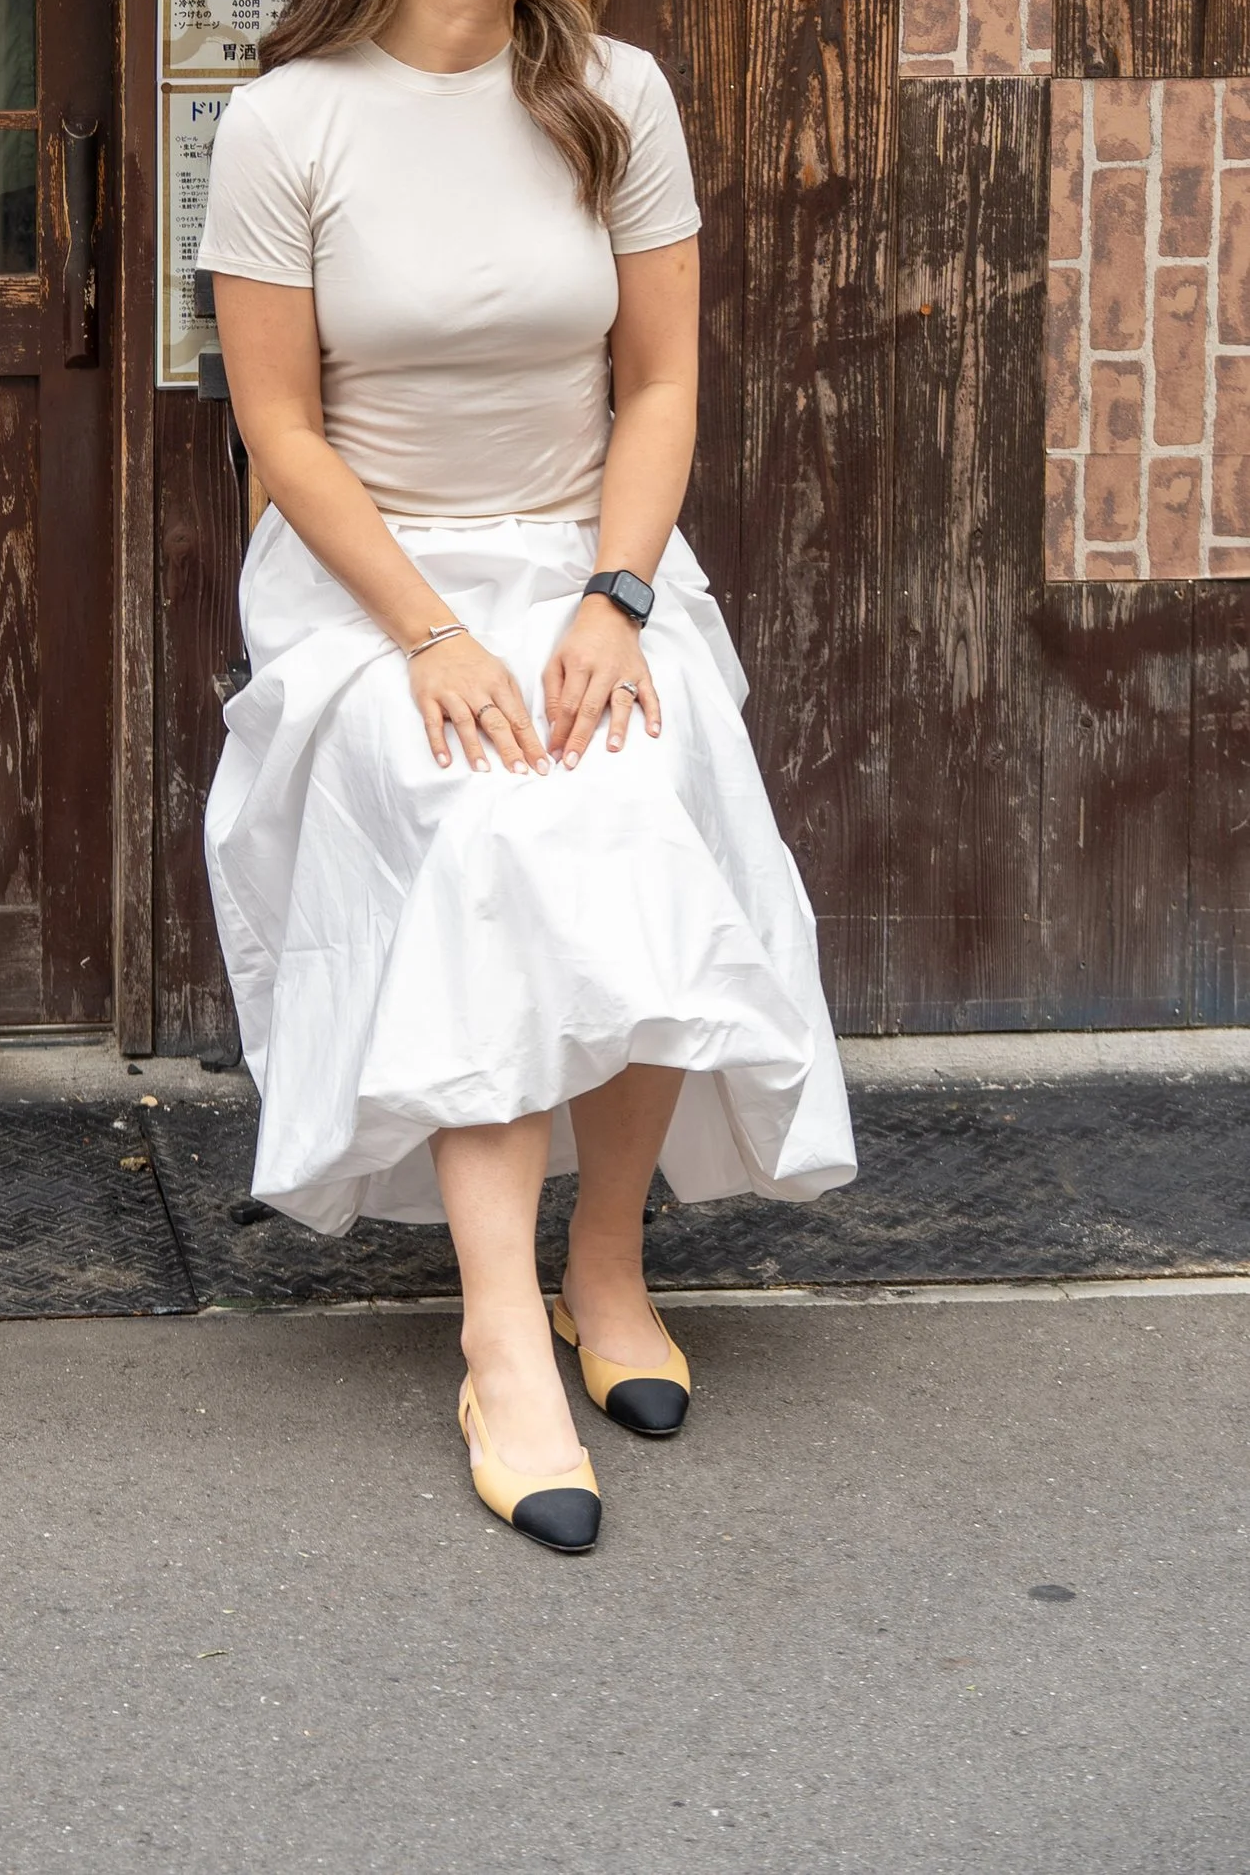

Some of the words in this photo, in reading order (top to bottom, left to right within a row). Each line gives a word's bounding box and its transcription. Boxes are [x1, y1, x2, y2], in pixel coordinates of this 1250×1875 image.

[231, 0, 260, 8] 400円
[178, 10, 211, 19] つけもの
[231, 10, 260, 19] 400円
[178, 21, 220, 30] ソーセージ
[231, 21, 260, 30] 700円
[191, 101, 229, 121] ドリ
